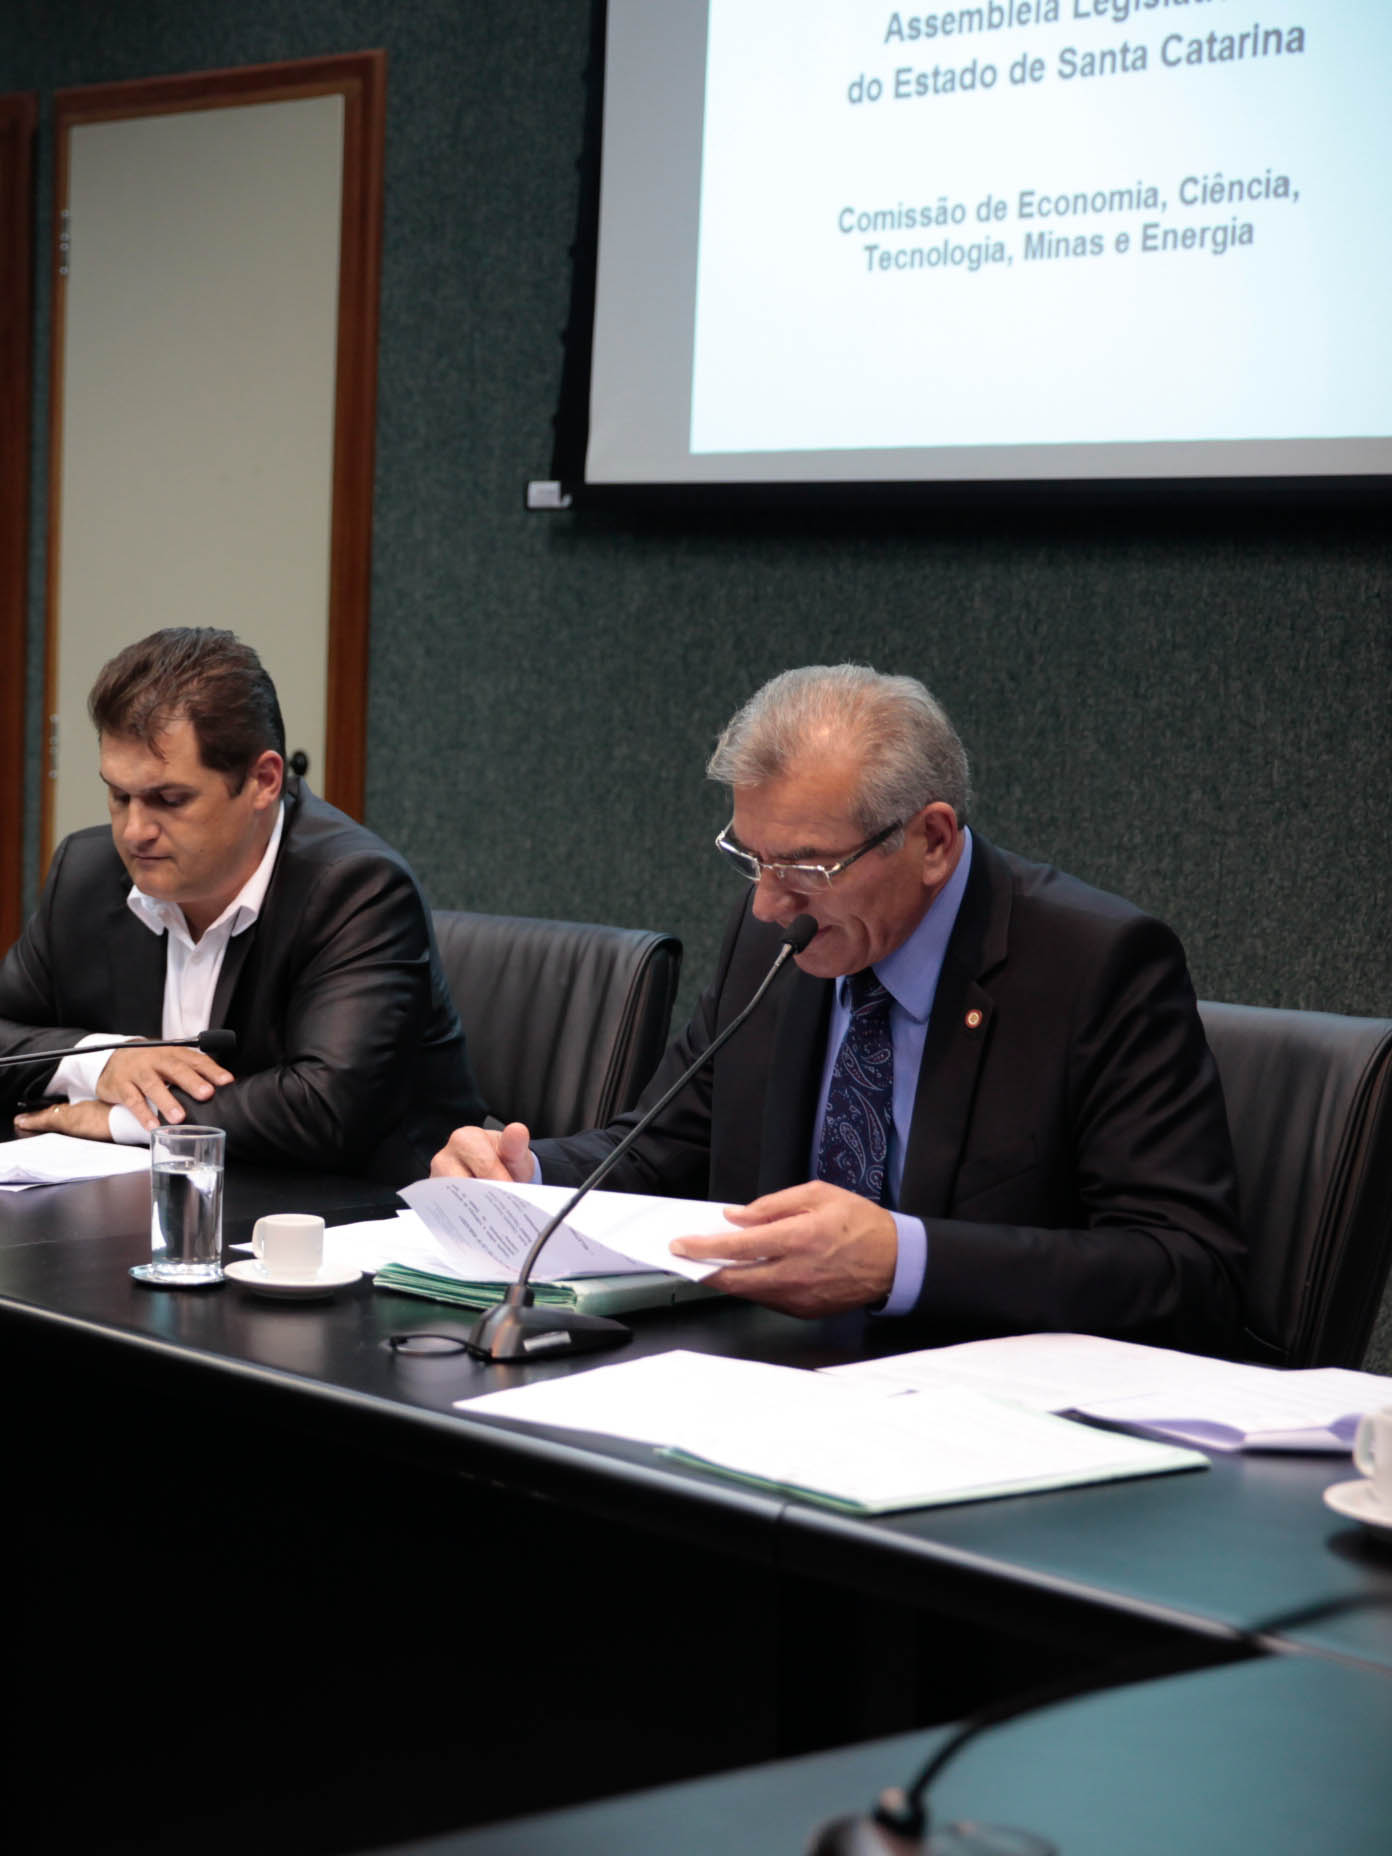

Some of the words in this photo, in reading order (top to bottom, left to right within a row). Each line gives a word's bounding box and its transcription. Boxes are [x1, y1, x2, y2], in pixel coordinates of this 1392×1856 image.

[884, 0, 1059, 43] Assembleia
[848, 72, 883, 104] do
[894, 58, 997, 99] Estado
[1009, 52, 1045, 85] de
[1058, 41, 1148, 79] Santa
[1161, 22, 1305, 67] Catarina
[838, 196, 966, 234] Comissão
[976, 194, 1008, 222] de
[1017, 180, 1167, 219] Economia,
[1179, 168, 1300, 205] Ciência,
[864, 235, 1013, 272] Tecnologia,
[1024, 230, 1104, 260] Minas
[1114, 231, 1131, 254] e
[1141, 216, 1254, 256] Energia
